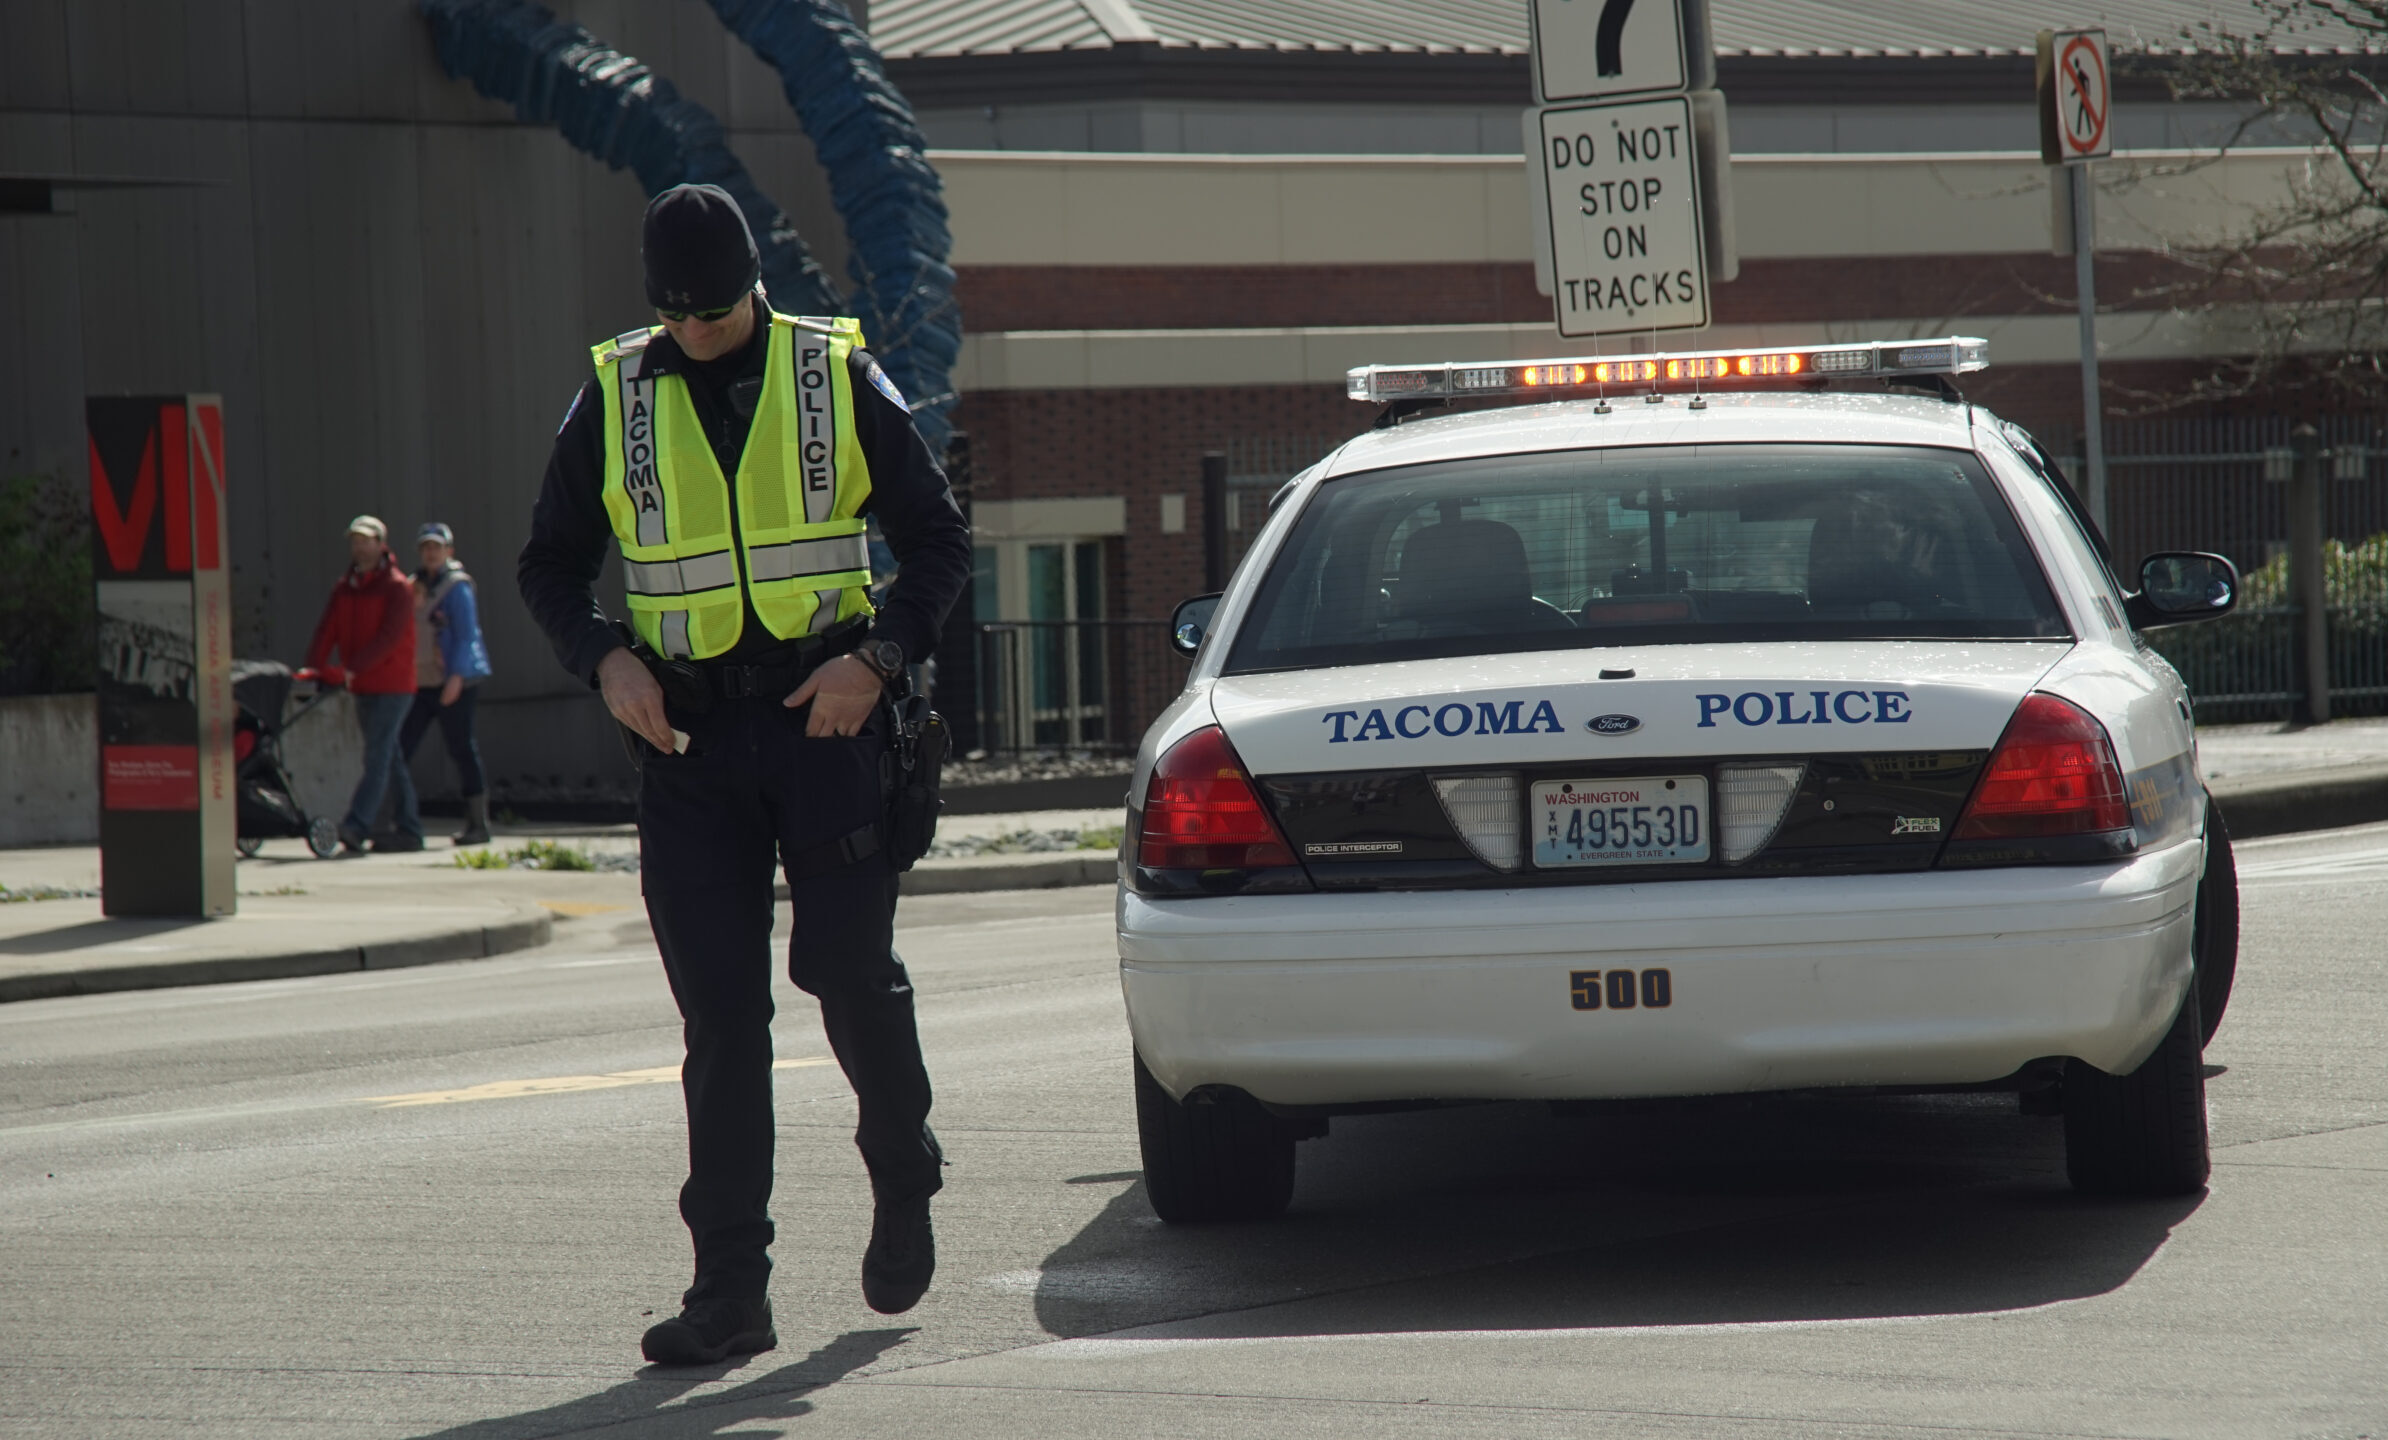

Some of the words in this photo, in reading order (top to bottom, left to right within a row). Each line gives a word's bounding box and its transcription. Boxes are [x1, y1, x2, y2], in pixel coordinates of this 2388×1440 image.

[1553, 134, 1595, 169] DO
[1617, 125, 1680, 163] NOT
[1579, 178, 1662, 216] STOP
[1604, 225, 1647, 260] ON
[1564, 270, 1694, 312] TRACKS
[800, 348, 829, 492] POLICE
[626, 376, 659, 513] TACOMA
[206, 590, 221, 669] TACOMA
[210, 674, 222, 711] ART
[1322, 700, 1565, 743] TACOMA
[1695, 690, 1912, 728] POLICE
[1598, 717, 1630, 730] Ford
[1545, 791, 1640, 805] WASHINGTON
[1308, 845, 1338, 853] POLICE
[1340, 843, 1399, 851] INTERCEPTOR
[1566, 805, 1699, 850] 49553D
[1580, 851, 1632, 860] EVERGREEN
[1636, 850, 1664, 858] STATE
[1569, 968, 1672, 1012] 500
